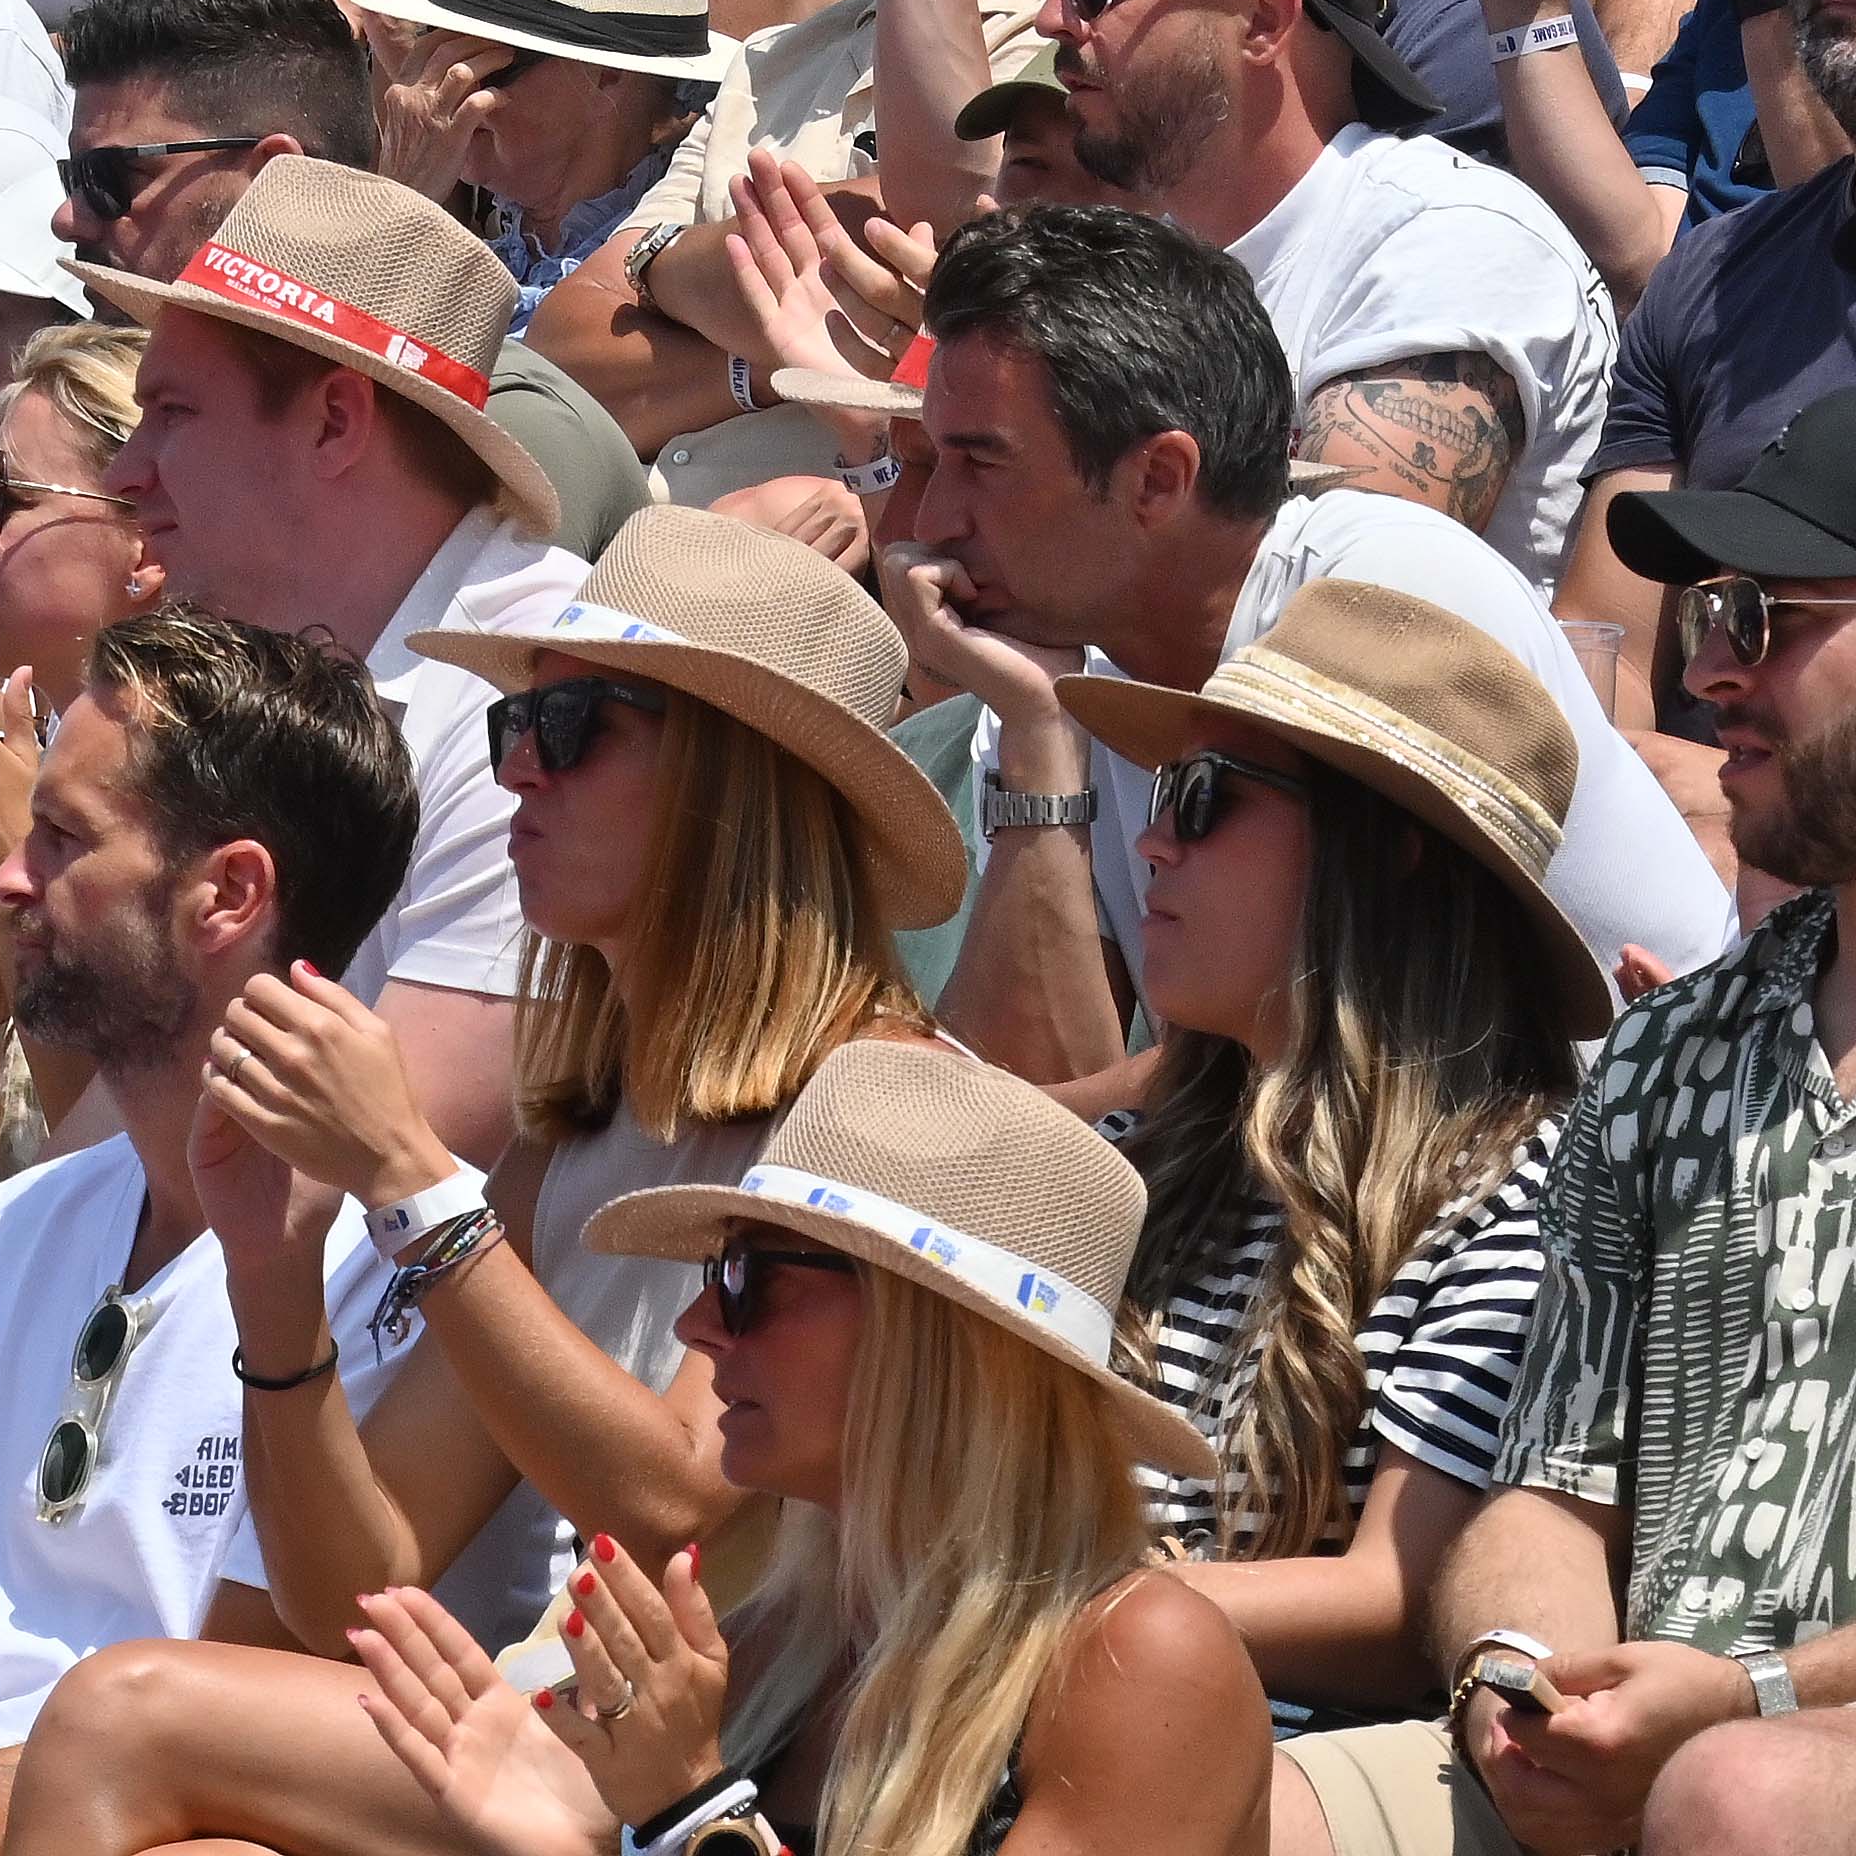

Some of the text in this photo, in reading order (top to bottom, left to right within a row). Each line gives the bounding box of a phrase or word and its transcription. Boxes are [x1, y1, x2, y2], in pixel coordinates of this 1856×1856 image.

[1532, 23, 1557, 43] GAME
[203, 246, 337, 325] VICTORIA
[732, 370, 746, 395] PLAY
